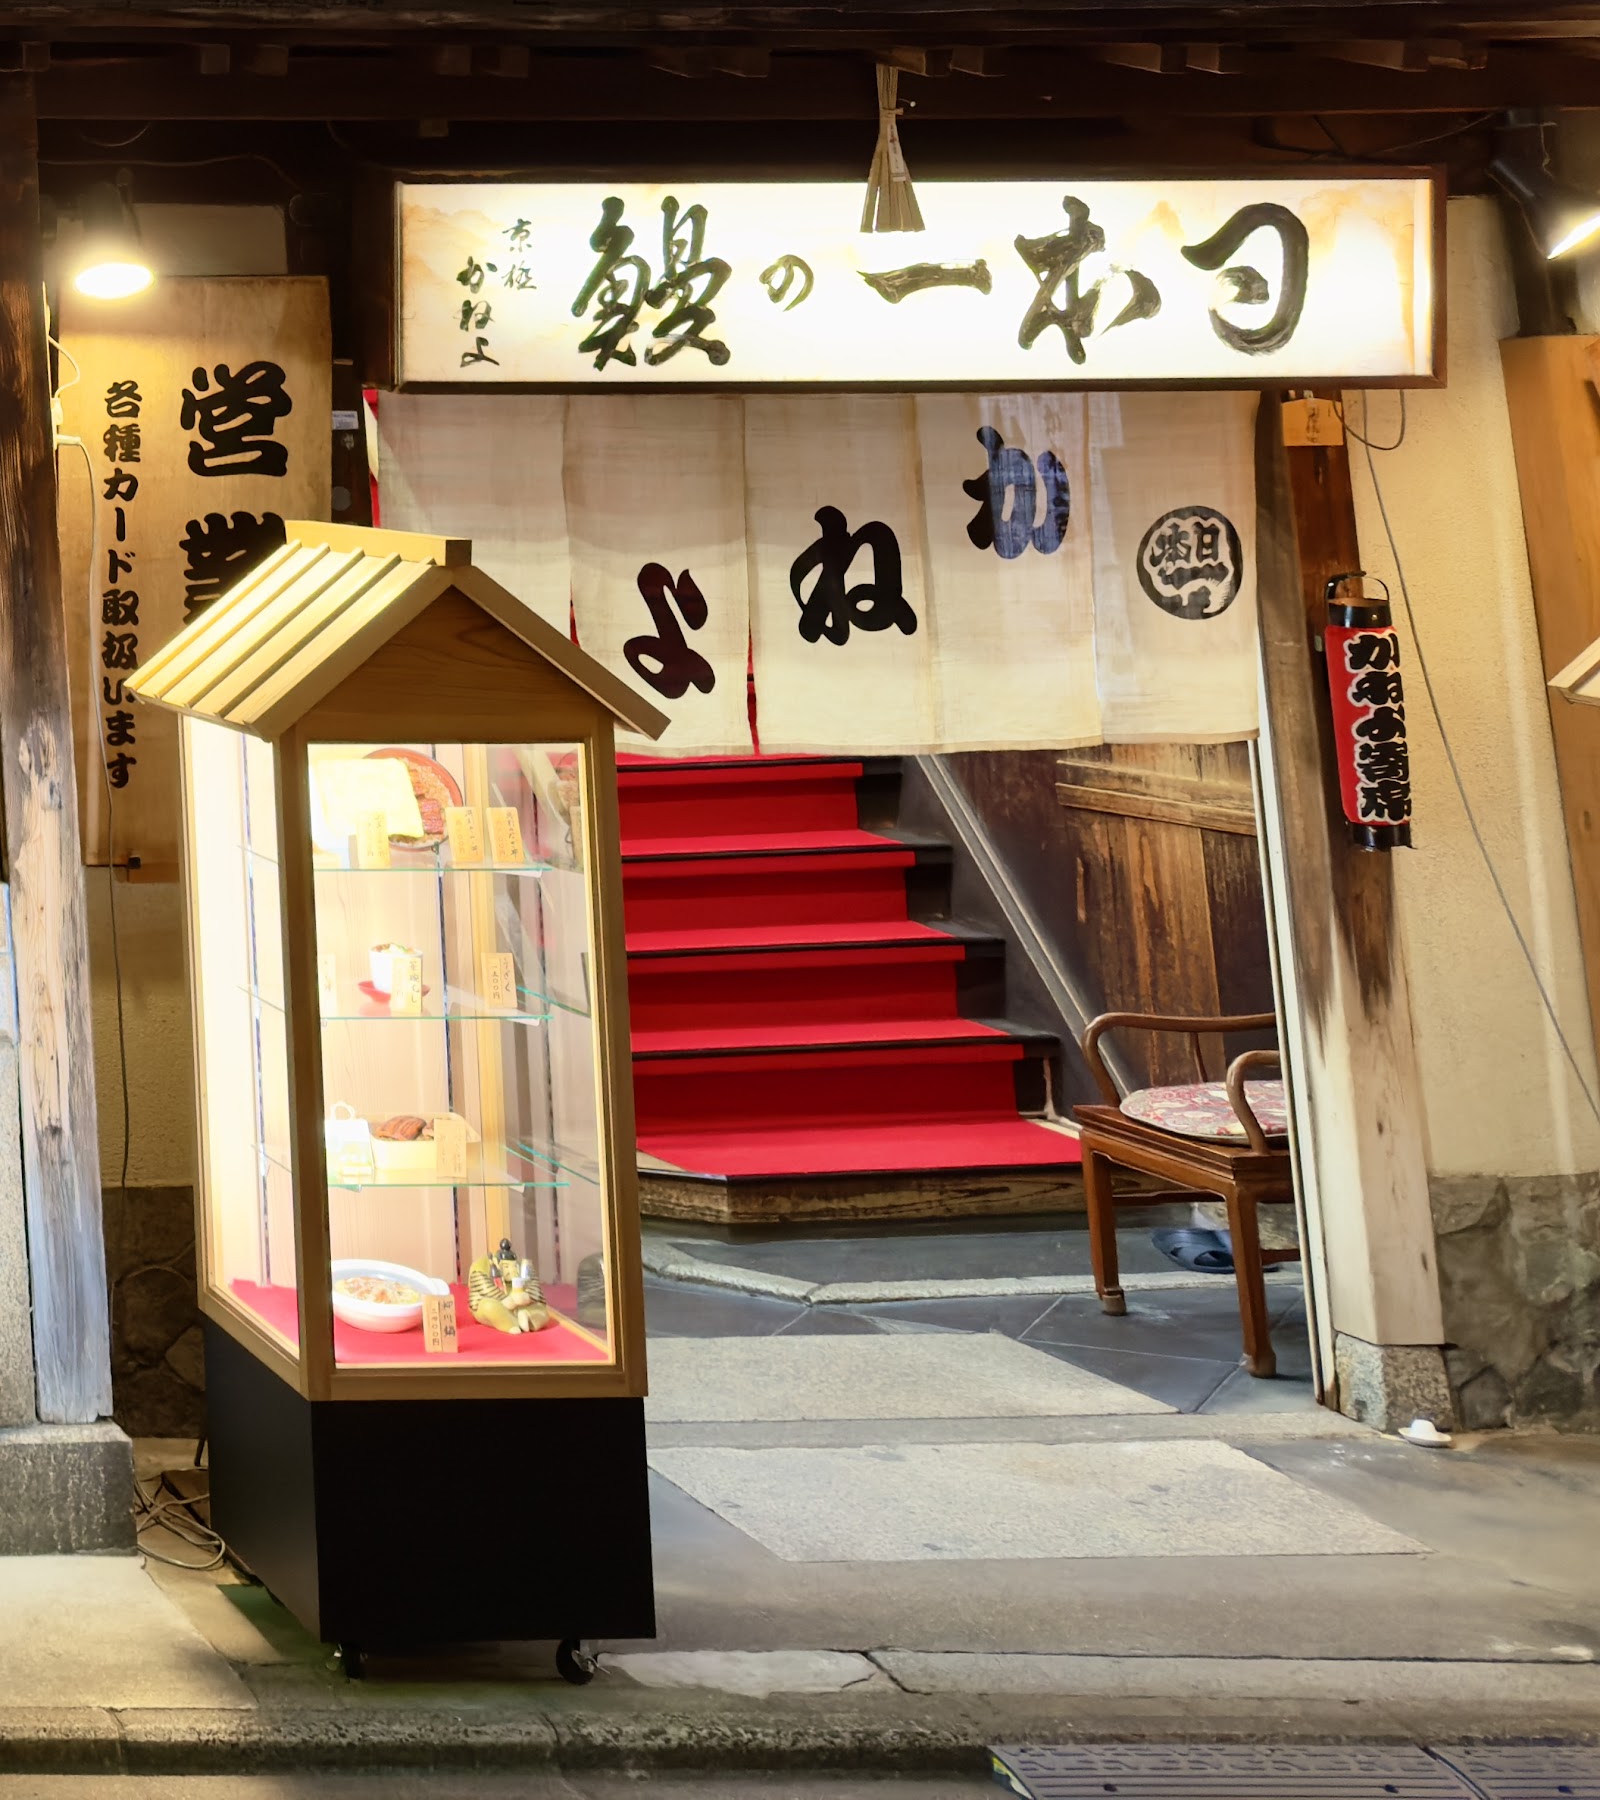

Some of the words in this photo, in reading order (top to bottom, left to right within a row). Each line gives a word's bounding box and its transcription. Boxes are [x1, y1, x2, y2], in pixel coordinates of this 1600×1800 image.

[502, 218, 537, 290] 京極
[453, 256, 500, 368] かねよ
[102, 380, 142, 788] 各種カード取扱います
